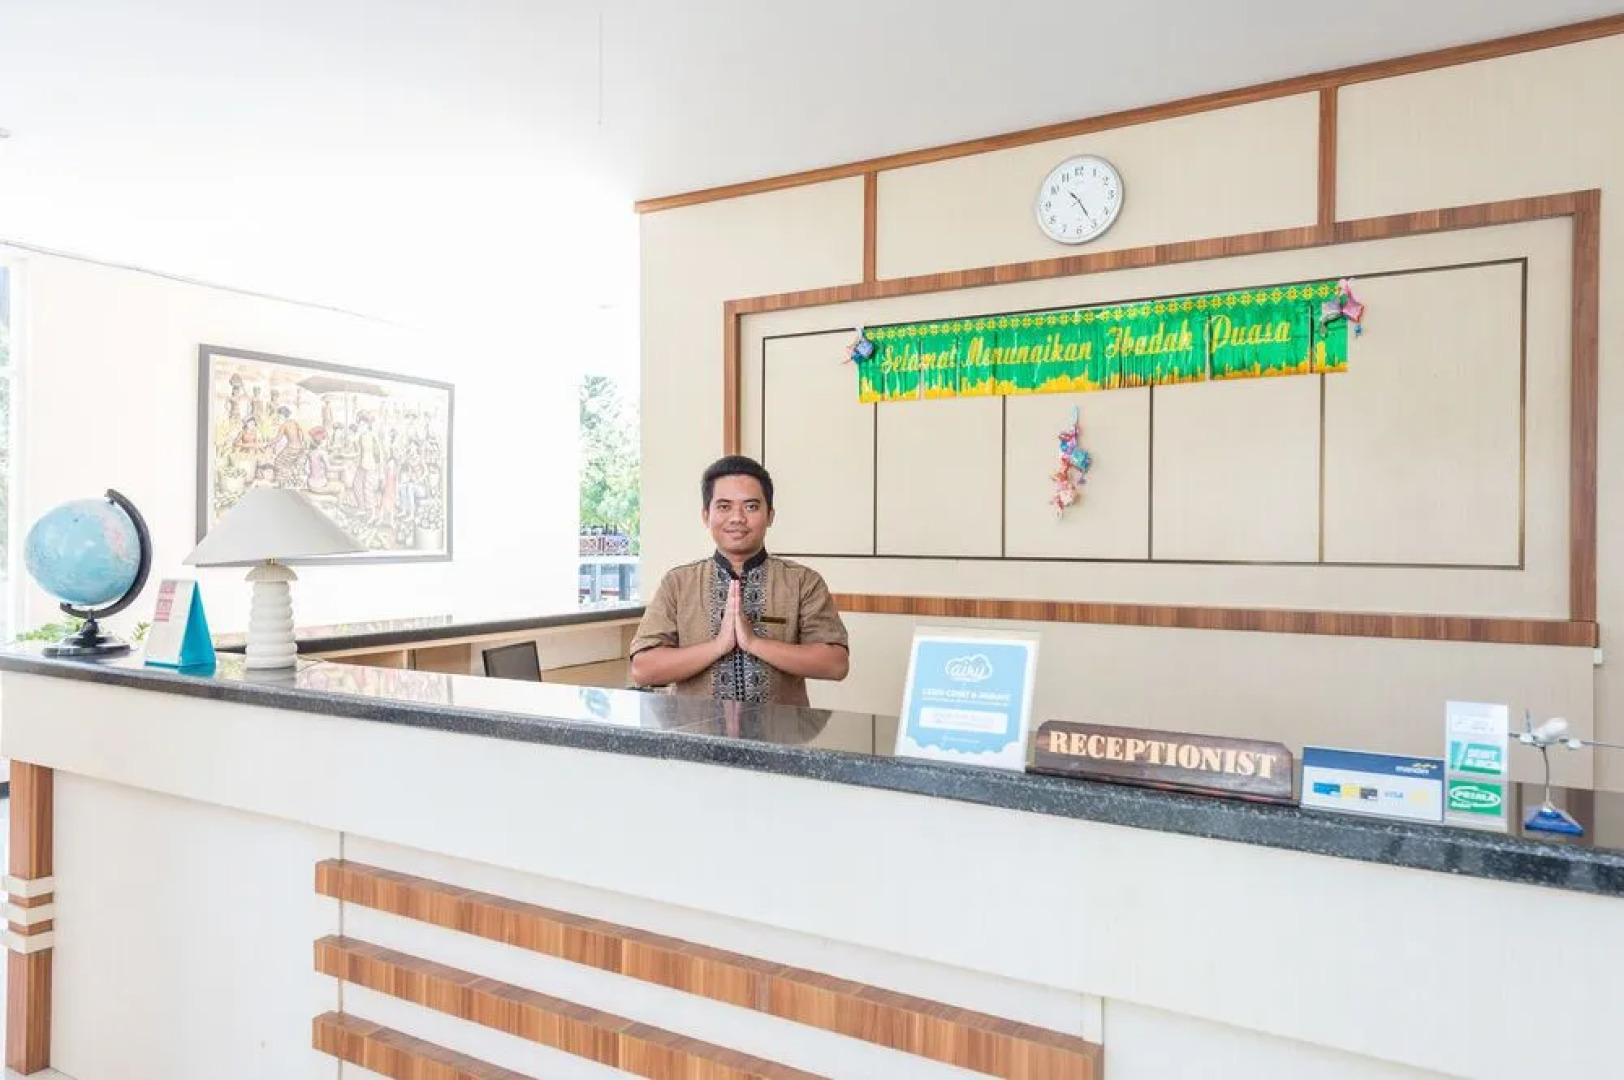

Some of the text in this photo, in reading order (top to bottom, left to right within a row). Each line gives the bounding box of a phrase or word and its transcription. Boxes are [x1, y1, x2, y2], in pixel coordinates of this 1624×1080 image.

[1074, 166, 1084, 176] 12
[1092, 168, 1097, 177] 1
[1061, 172, 1070, 183] 11
[1102, 176, 1109, 186] 2
[1050, 185, 1060, 195] 10
[1108, 189, 1115, 199] 3
[1045, 201, 1052, 211] 9
[881, 343, 957, 374] Selamat
[1104, 318, 1194, 359] Ibadah
[1209, 314, 1291, 355] Puasa
[1049, 730, 1277, 778] RECEPTIONIST
